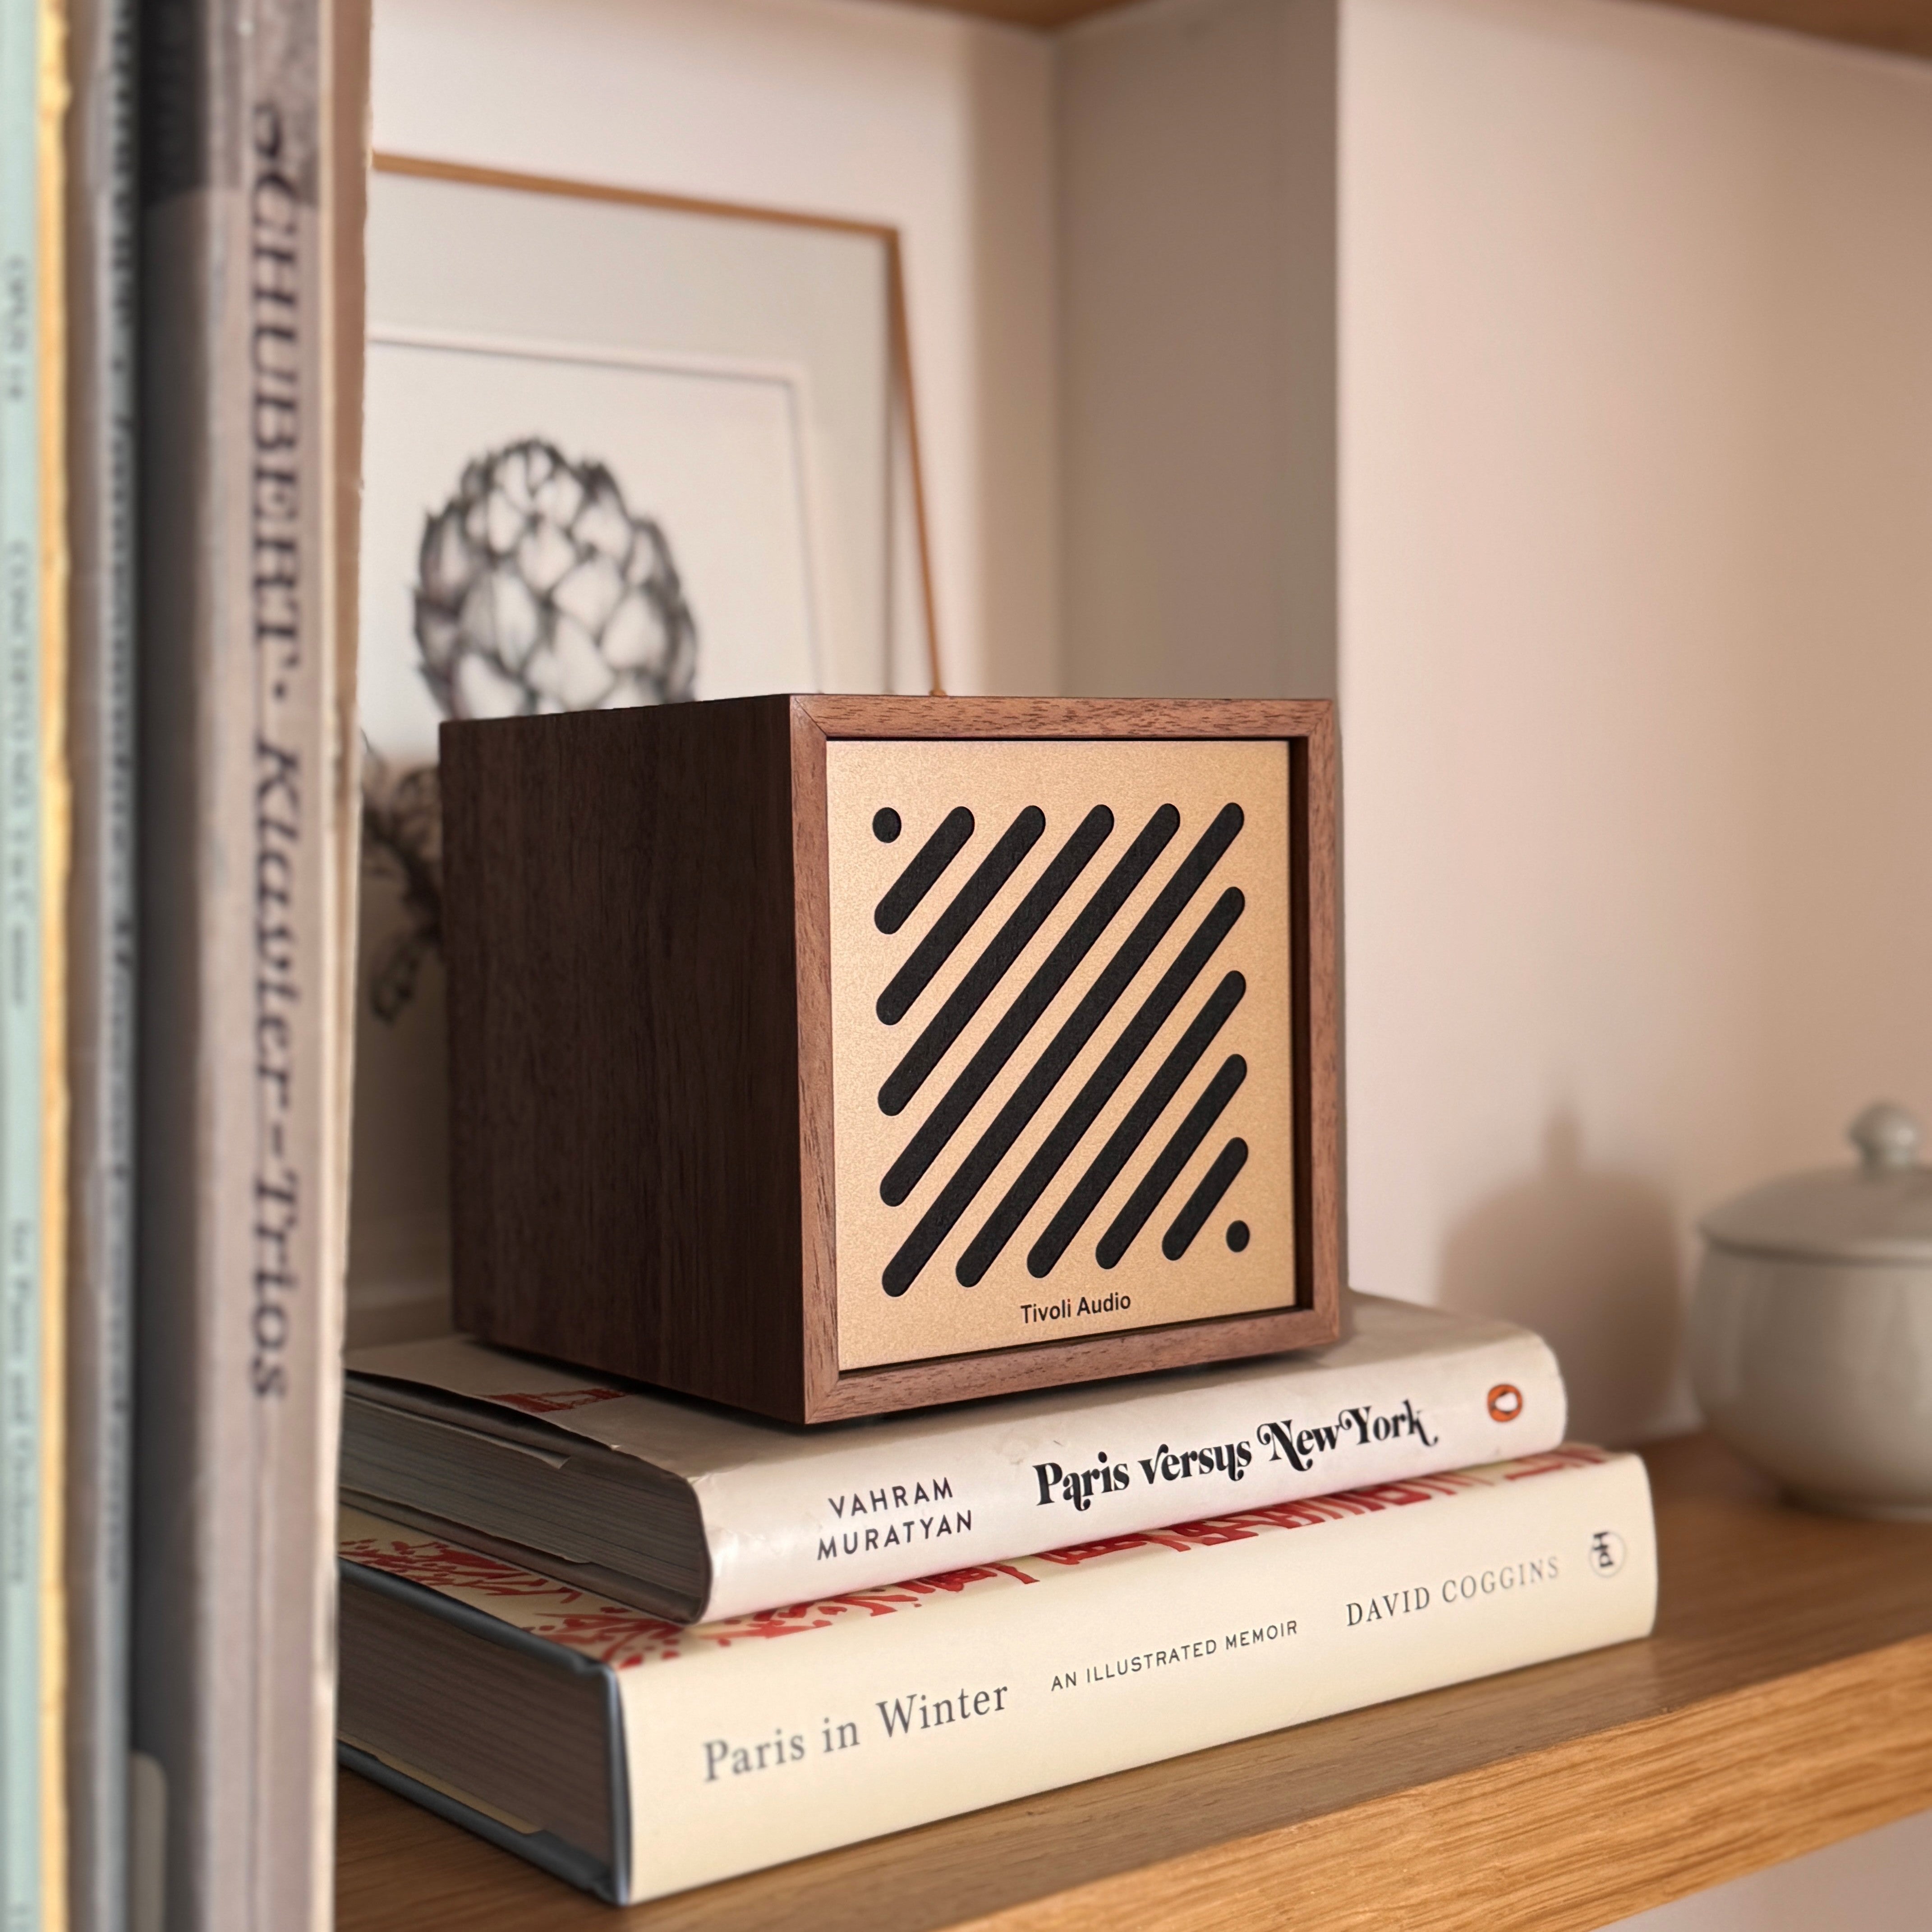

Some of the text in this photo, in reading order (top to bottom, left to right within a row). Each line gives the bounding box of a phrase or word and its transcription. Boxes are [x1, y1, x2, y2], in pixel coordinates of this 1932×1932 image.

[1021, 1292, 1131, 1324] Tivoli Audio
[1032, 1398, 1439, 1511] Paris versus New York
[828, 1477, 953, 1518] VAHRAM
[817, 1509, 971, 1560] MURATYAN
[1346, 1556, 1559, 1626] DAVID COGGINS
[1051, 1620, 1297, 1691] AN ILLUSTRATED MEMOIR
[703, 1685, 1008, 1782] Paris in Winter
